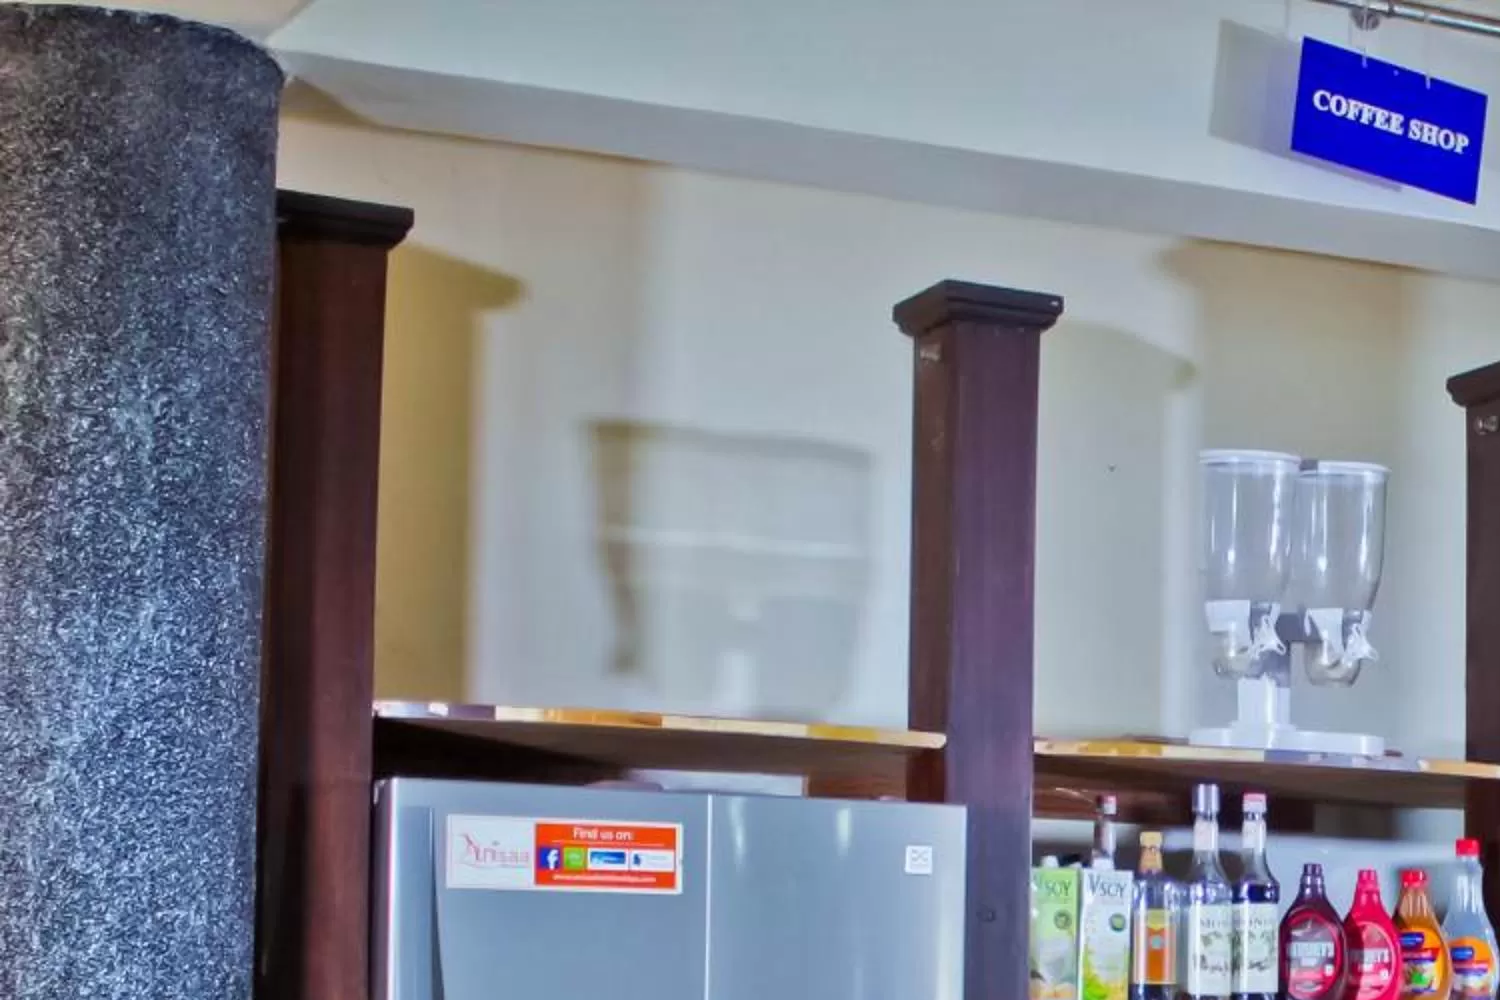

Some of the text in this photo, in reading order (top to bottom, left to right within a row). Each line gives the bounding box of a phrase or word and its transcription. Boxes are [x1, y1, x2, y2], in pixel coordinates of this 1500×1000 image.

[1312, 89, 1470, 155] COFFEE SHOP
[573, 827, 598, 840] Find
[600, 830, 614, 840] us
